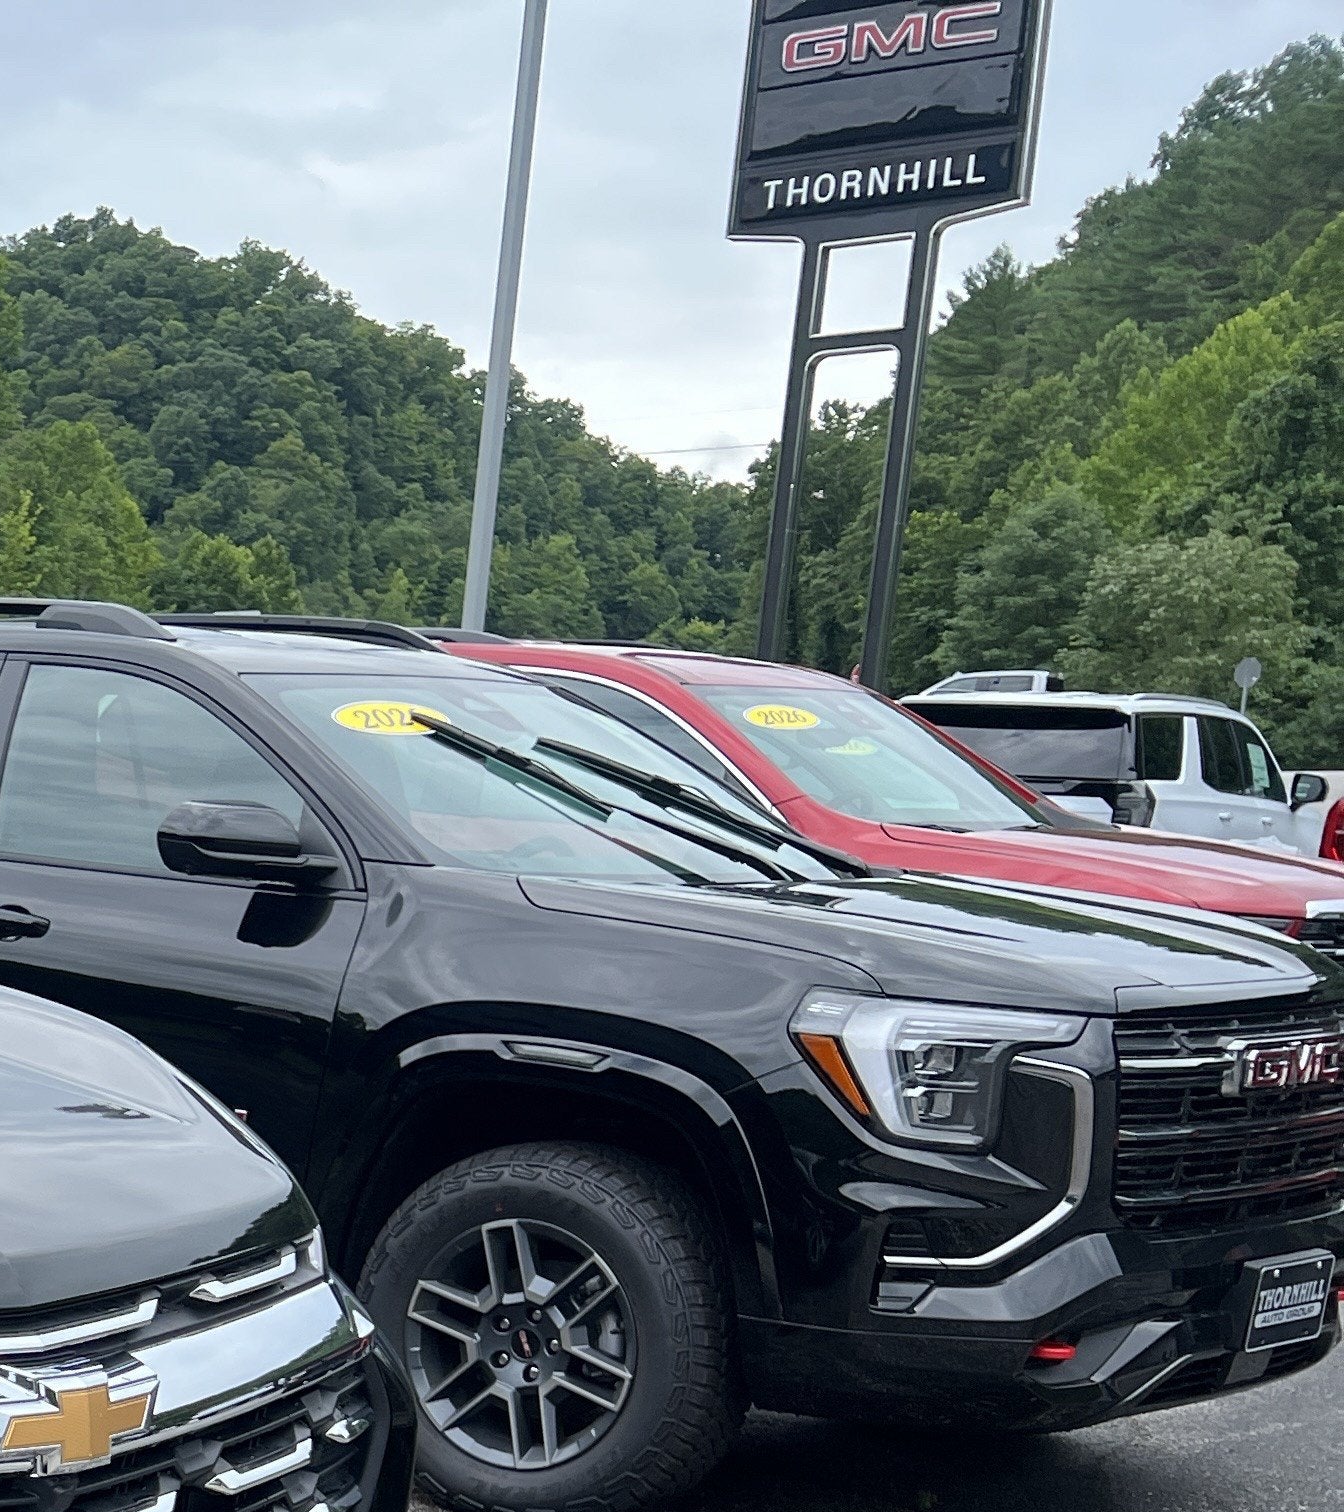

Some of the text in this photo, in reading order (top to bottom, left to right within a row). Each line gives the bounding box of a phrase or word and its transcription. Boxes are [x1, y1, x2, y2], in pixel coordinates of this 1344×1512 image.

[782, 1, 1001, 73] GMC
[763, 153, 986, 210] THORNHILL
[353, 708, 415, 729] 202
[1258, 1279, 1325, 1312] THORNHILL
